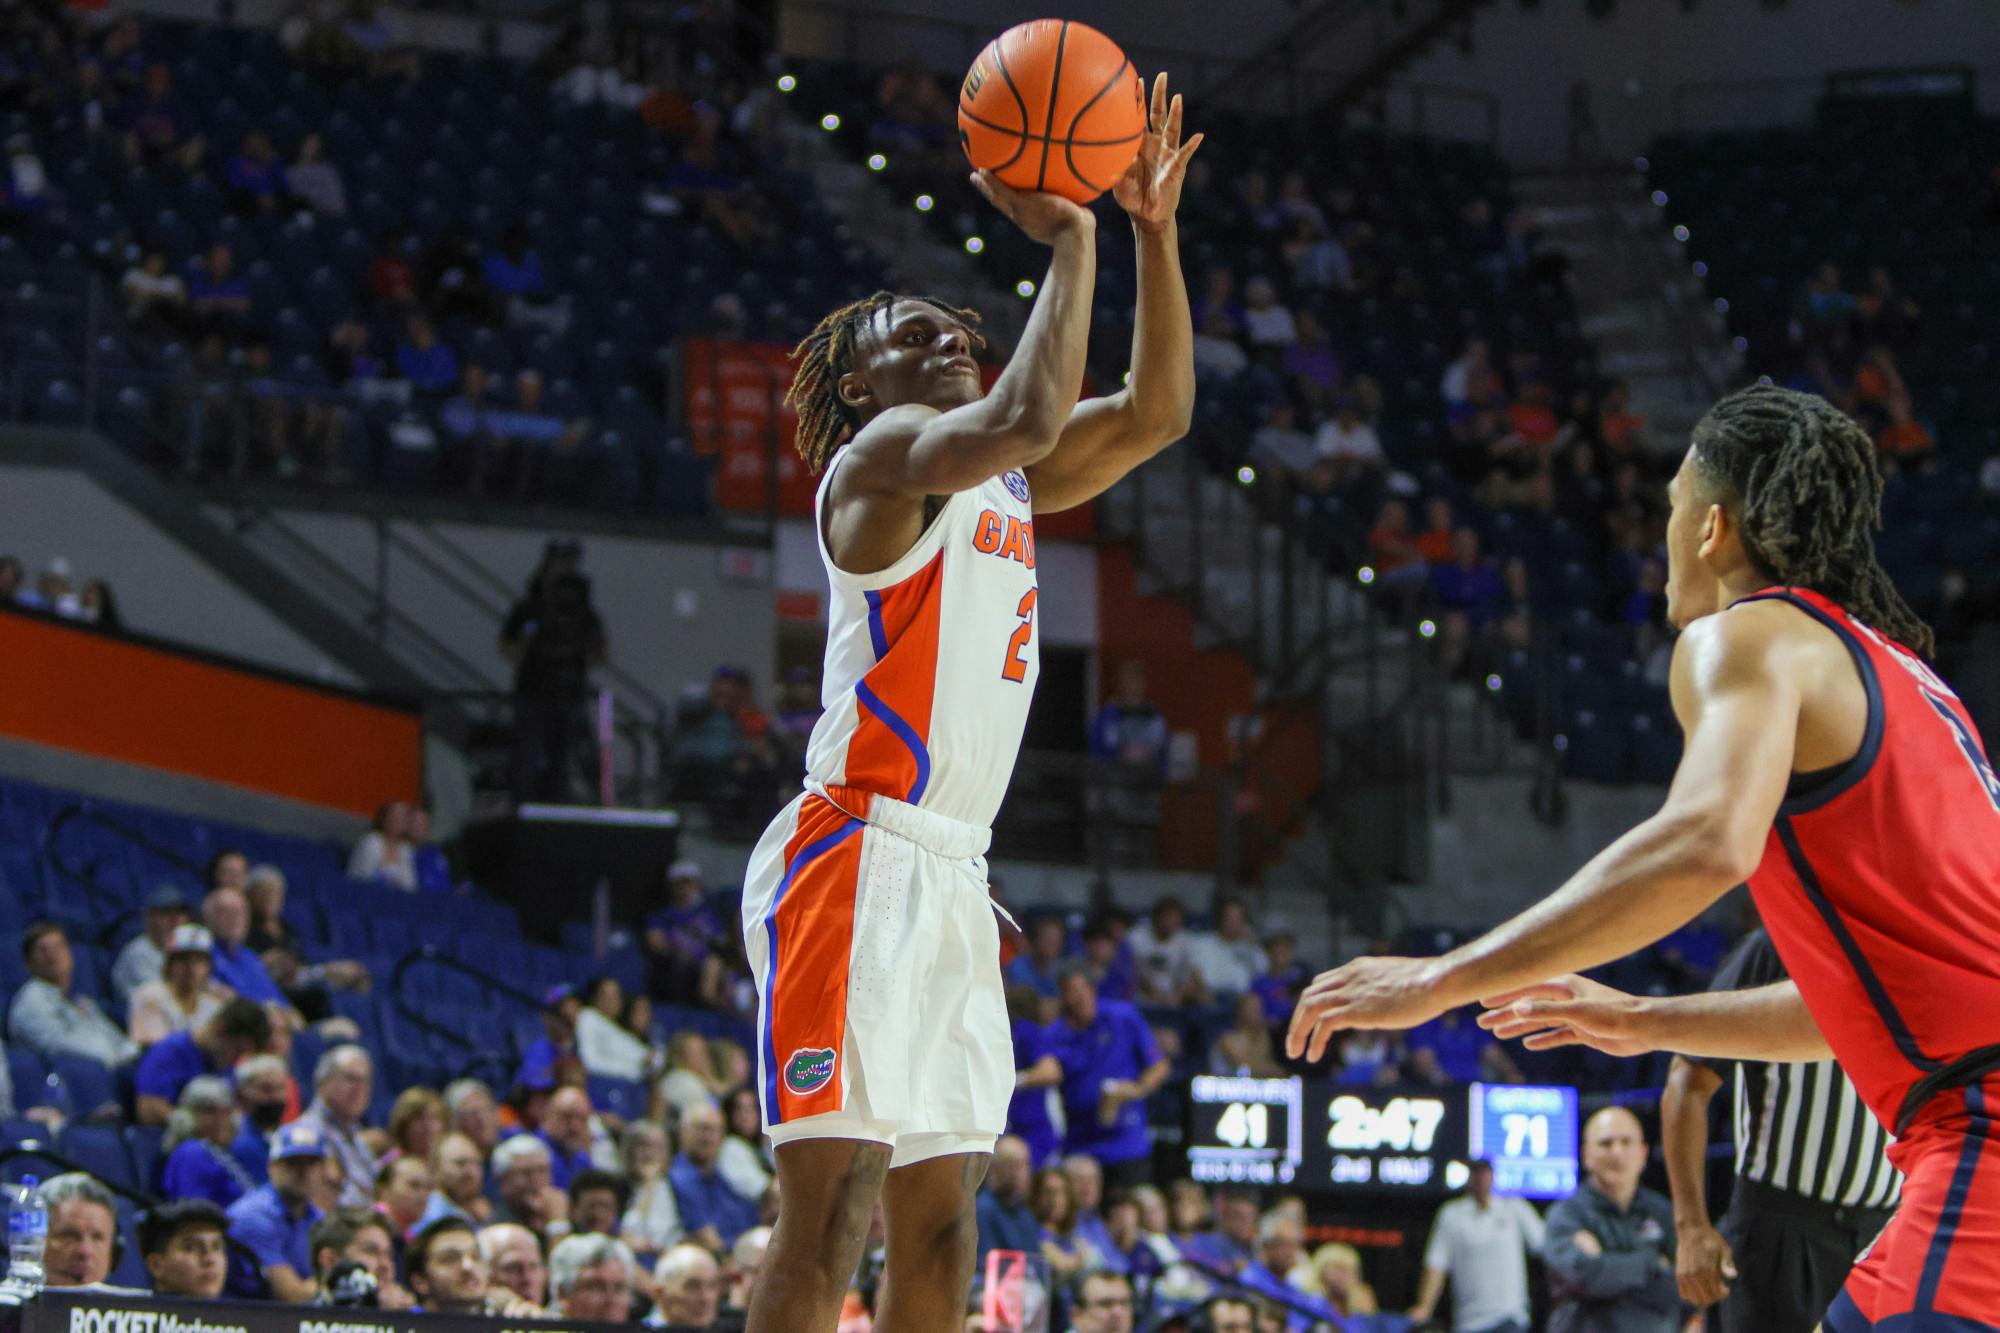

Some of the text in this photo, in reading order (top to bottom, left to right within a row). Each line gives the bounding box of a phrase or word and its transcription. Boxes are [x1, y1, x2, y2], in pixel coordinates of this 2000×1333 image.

[1001, 586, 1038, 684] 2
[1216, 1103, 1267, 1148] 41
[1328, 1095, 1445, 1151] 2:47
[1501, 1113, 1549, 1158] 71
[69, 1307, 158, 1333] ROCKET
